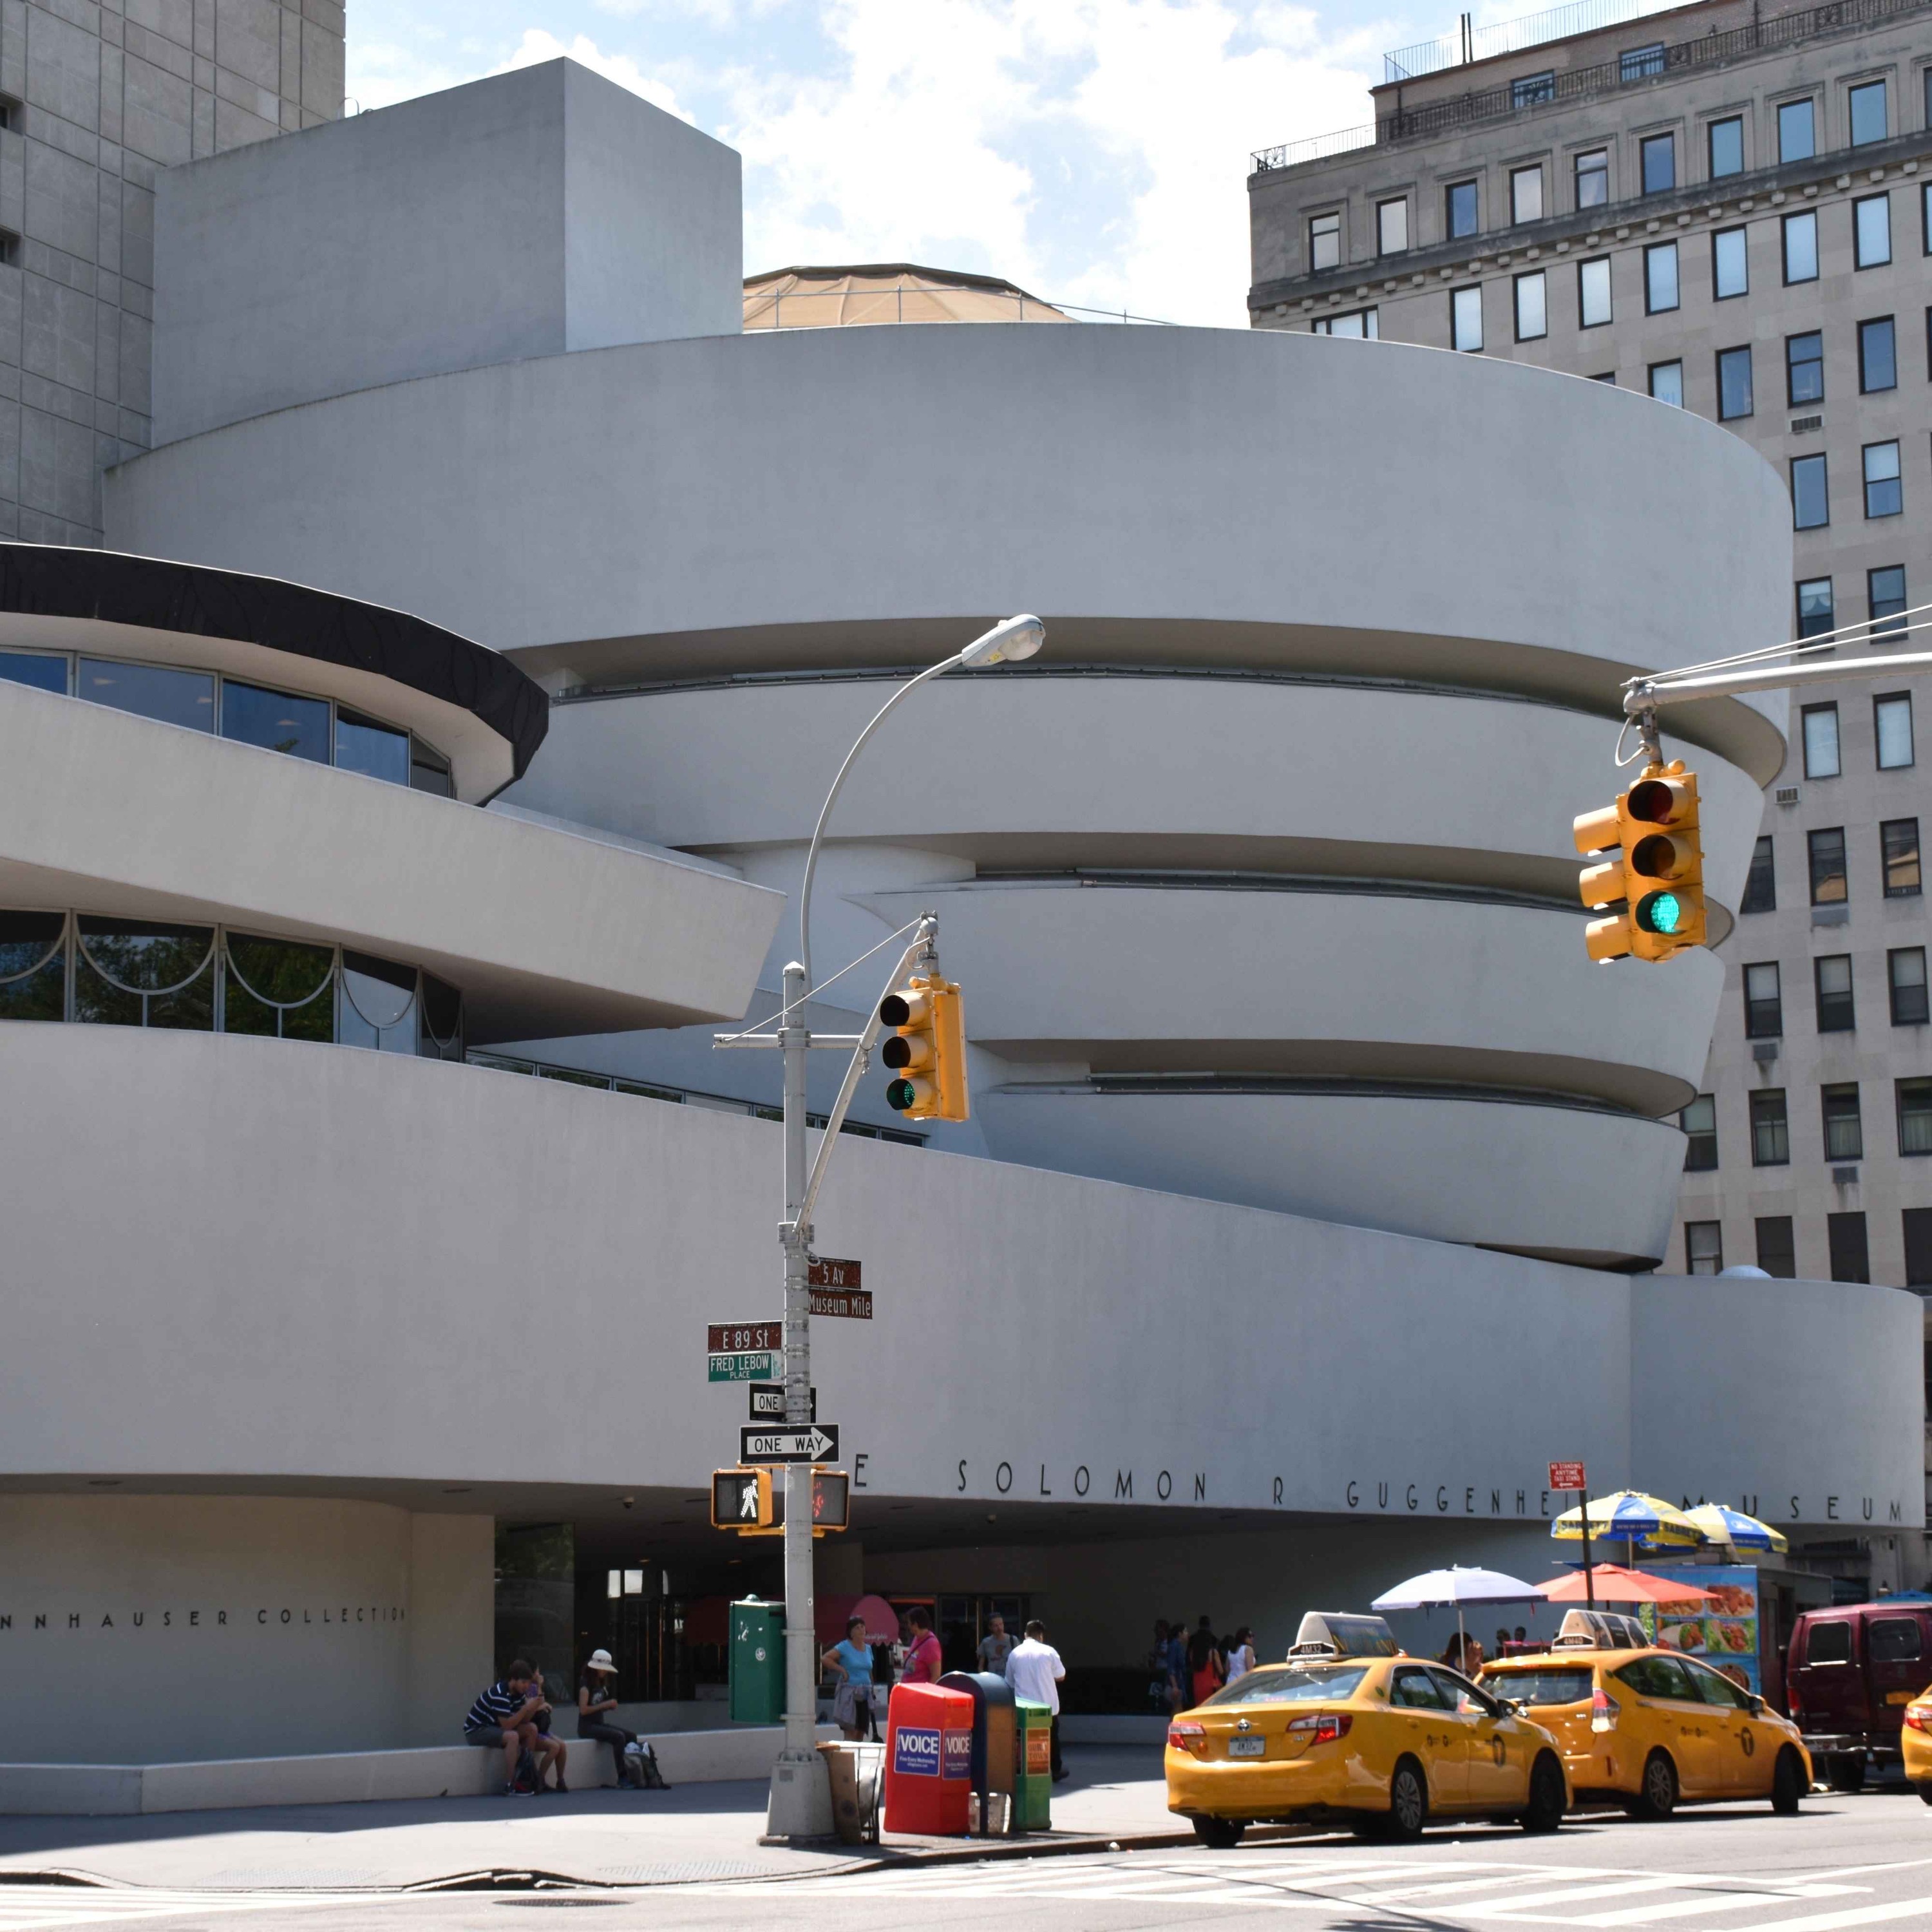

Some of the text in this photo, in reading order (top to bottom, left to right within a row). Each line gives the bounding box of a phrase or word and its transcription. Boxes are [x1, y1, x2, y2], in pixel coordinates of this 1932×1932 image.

[823, 1264, 844, 1285] 5 Av
[809, 1294, 871, 1316] Museum Mile
[723, 1329, 768, 1349] E 89 St
[710, 1354, 769, 1372] FRED LEBOW
[730, 1370, 750, 1379] PLACE
[759, 1395, 778, 1410] ONE
[754, 1437, 824, 1452] ONE WAY
[958, 1459, 1206, 1501] SOLOMON
[1273, 1476, 1283, 1505] R
[1347, 1481, 1593, 1516] GUGGENHEI
[0, 1611, 227, 1629] NNHAUSER
[1300, 1644, 1322, 1654] 4M32
[900, 1734, 938, 1754] VOICE
[947, 1736, 970, 1754] VOICE
